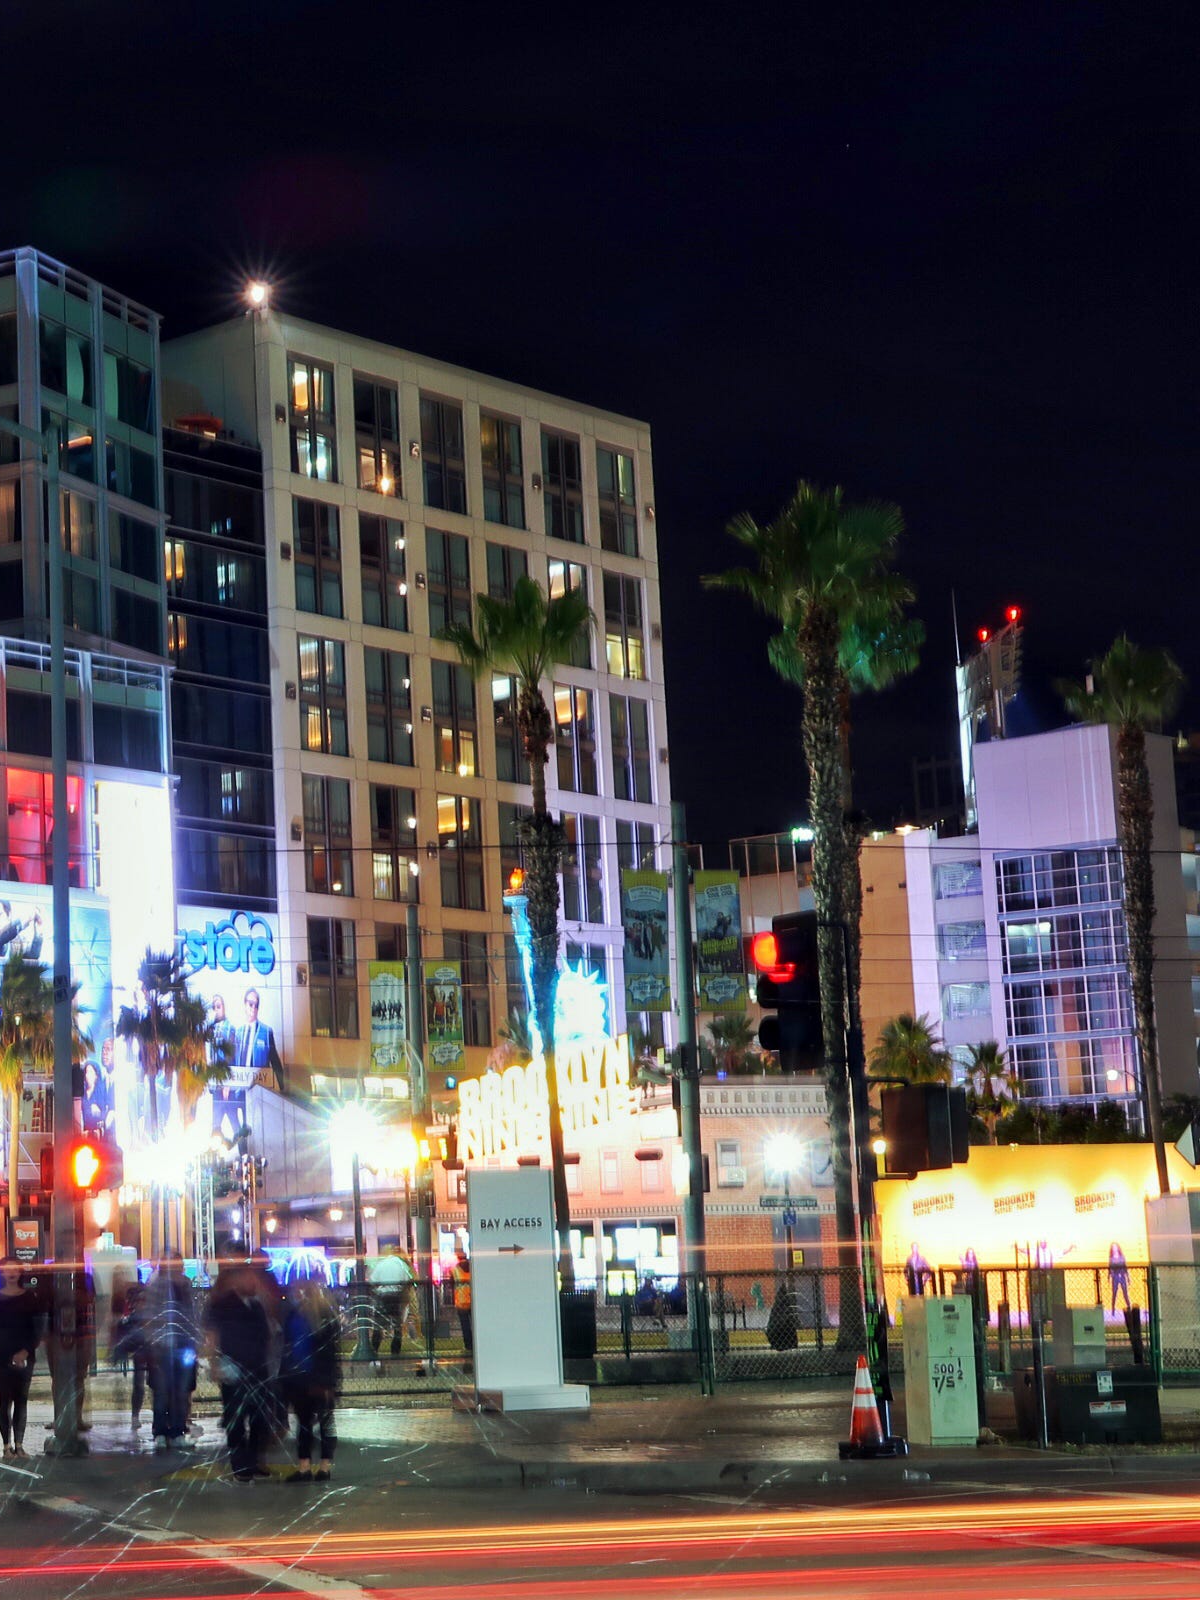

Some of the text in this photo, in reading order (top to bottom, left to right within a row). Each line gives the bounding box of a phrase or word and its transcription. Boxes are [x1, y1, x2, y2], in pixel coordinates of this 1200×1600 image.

[913, 1193, 955, 1210] BROOKLYN
[994, 1191, 1036, 1208] BROOKLYN
[1074, 1191, 1116, 1206] BROOKLYN
[913, 1202, 955, 1217] NINE NINE
[994, 1200, 1036, 1215] NINE NINE
[1075, 1203, 1094, 1214] NINE
[480, 1217, 543, 1229] BAY ACCESS
[934, 1364, 954, 1374] 500
[932, 1374, 955, 1394] T/S
